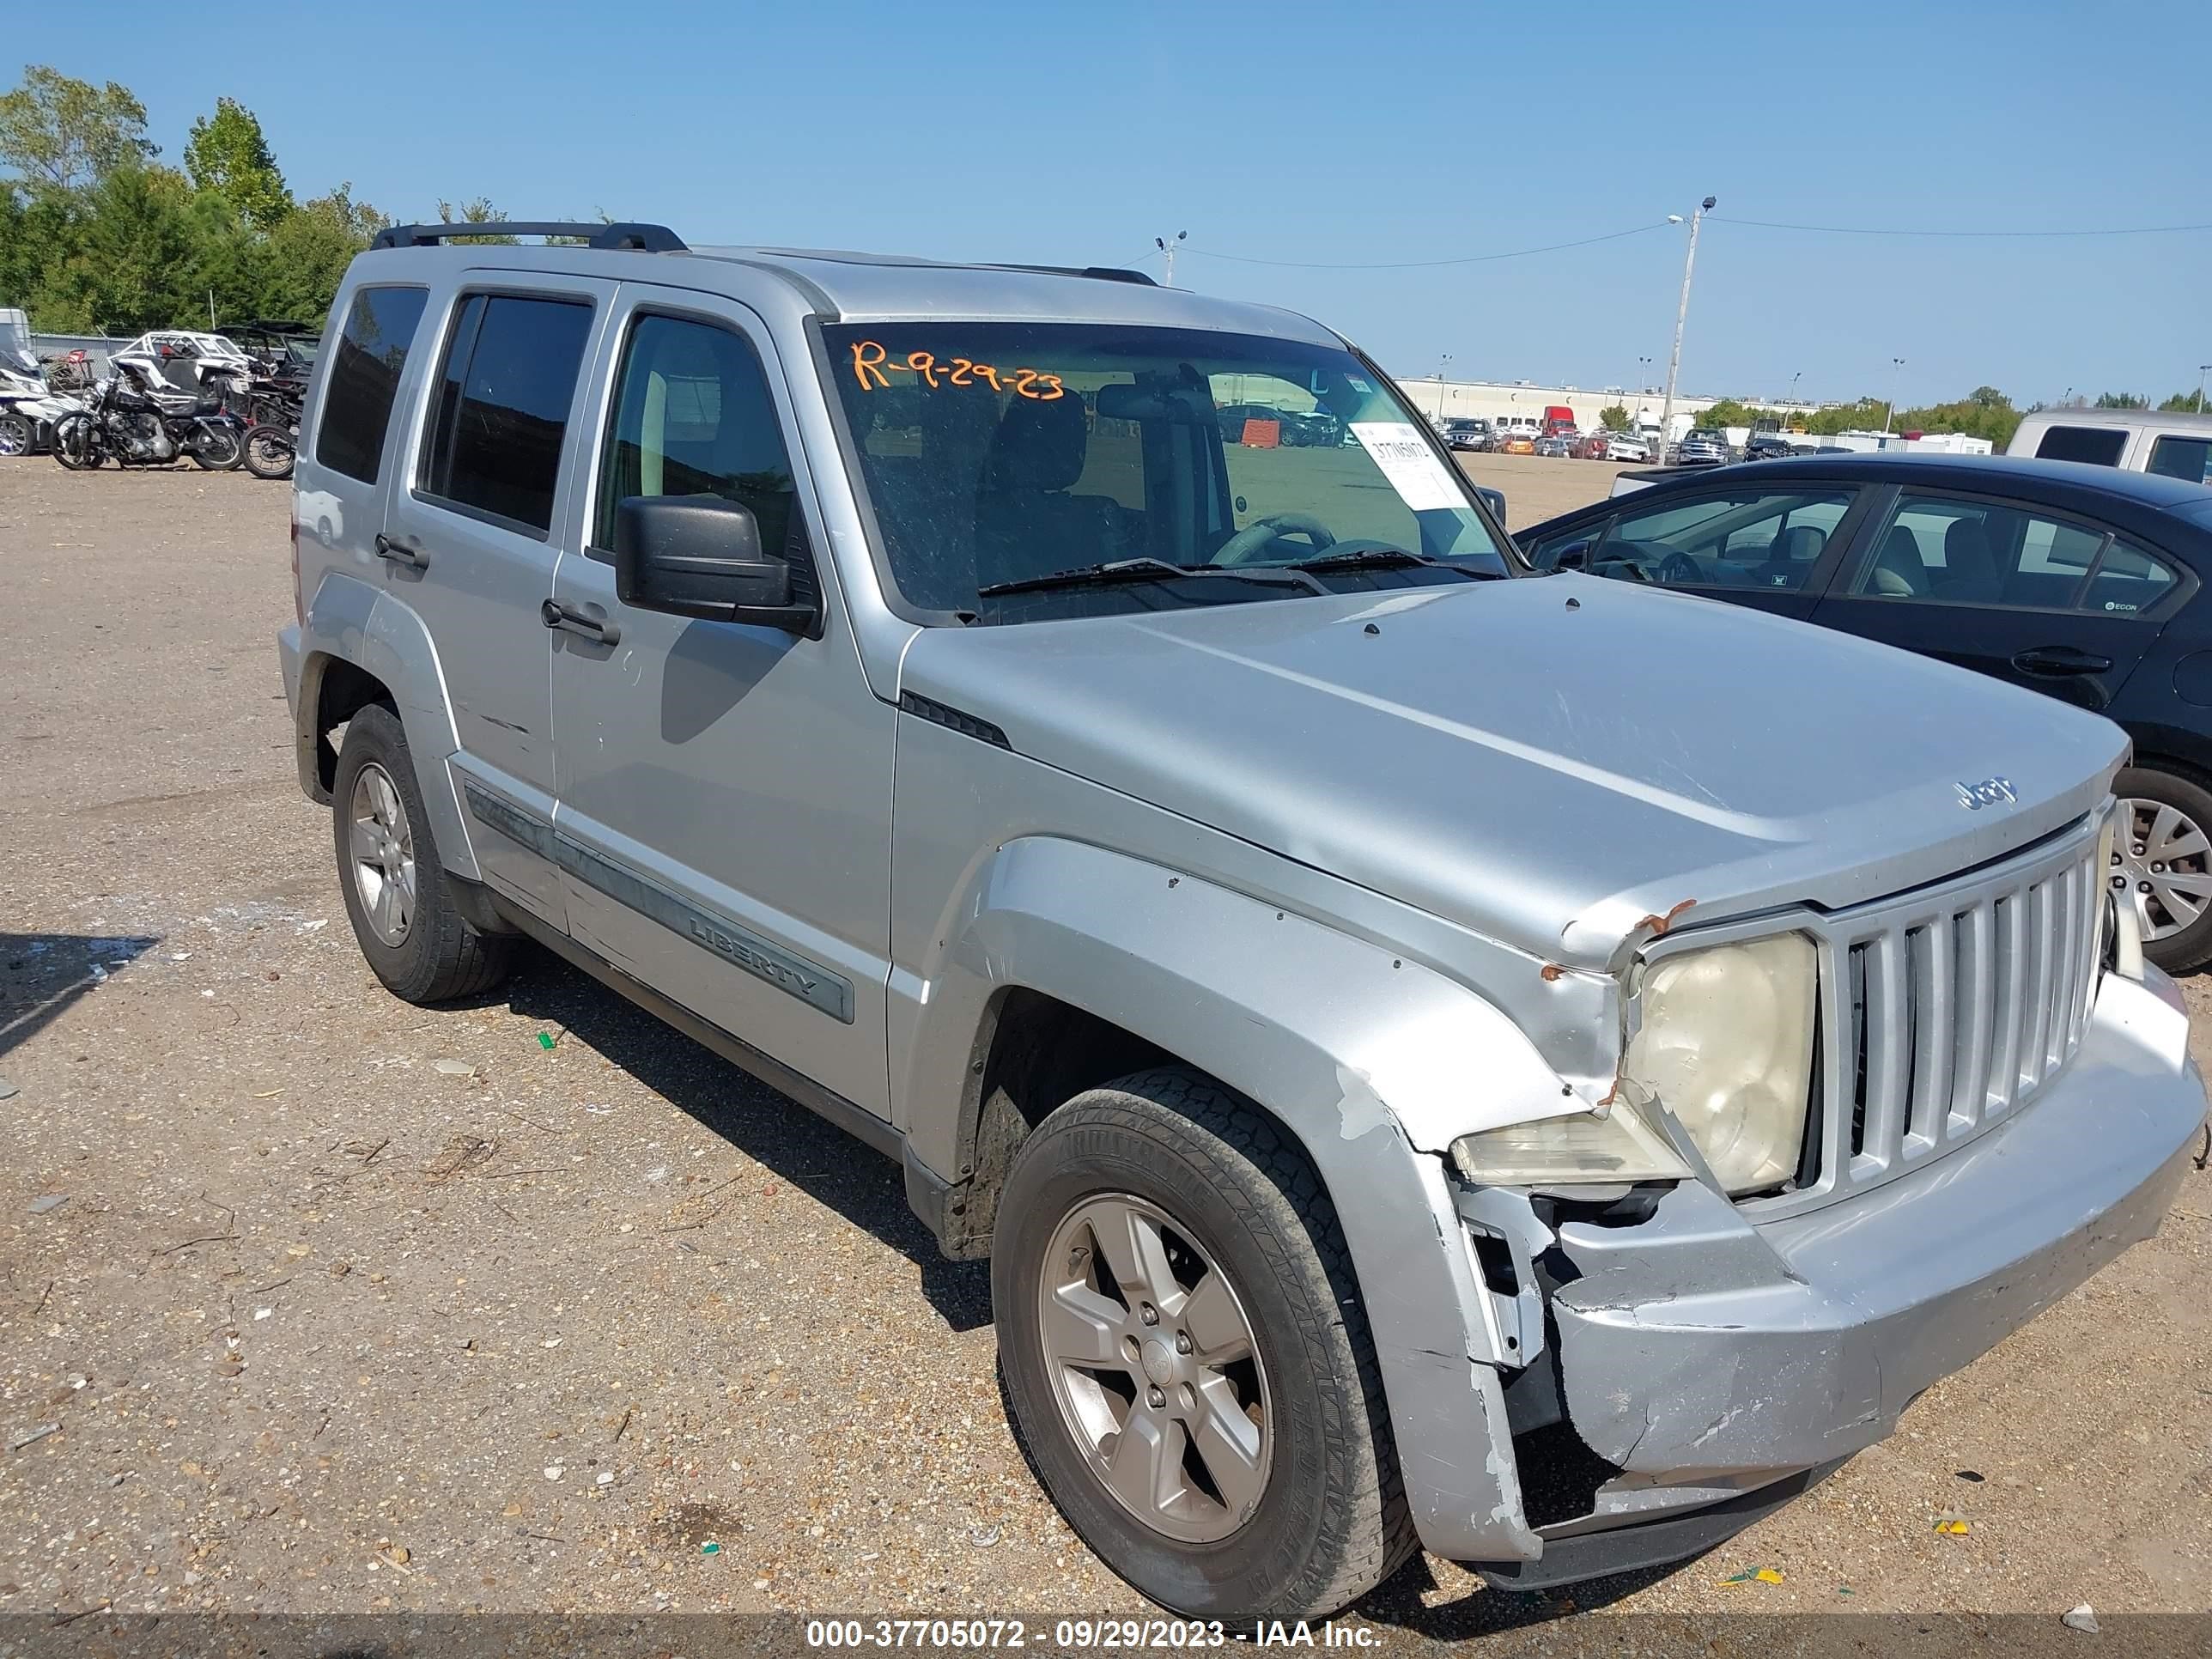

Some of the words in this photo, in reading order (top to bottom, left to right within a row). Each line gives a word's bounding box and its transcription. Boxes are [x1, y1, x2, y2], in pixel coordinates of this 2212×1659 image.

[849, 339, 1065, 400] R-9-29-23
[1951, 776, 2018, 811] Jeep
[690, 918, 817, 995] LIBERTY
